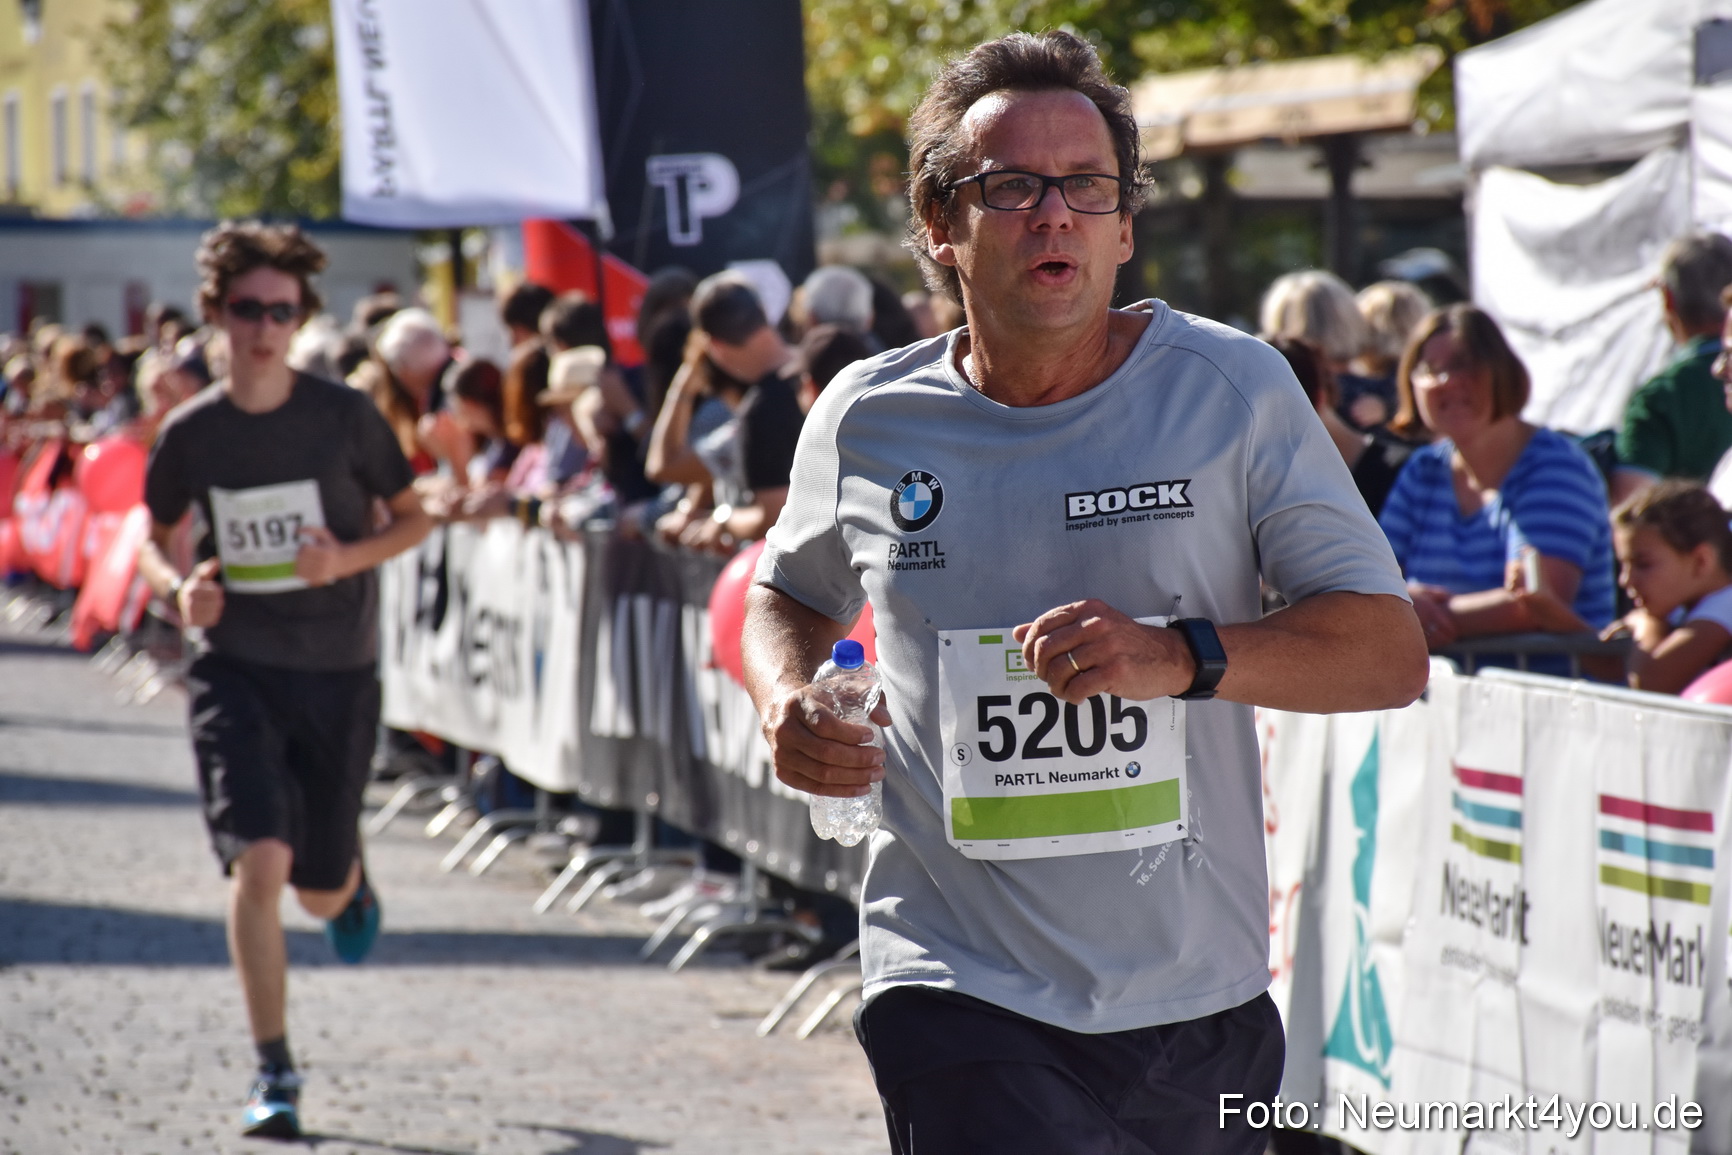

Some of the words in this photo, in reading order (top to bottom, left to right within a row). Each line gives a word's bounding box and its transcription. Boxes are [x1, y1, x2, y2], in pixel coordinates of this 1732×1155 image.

[895, 471, 940, 494] BMW
[1065, 480, 1193, 519] BOCK
[1065, 519, 1104, 531] inspired
[1107, 517, 1119, 526] by
[1121, 513, 1150, 524] smart
[1153, 510, 1195, 520] concepts
[227, 513, 304, 550] 5197
[888, 541, 945, 558] PARTL
[887, 558, 946, 571] Neumarkt
[977, 692, 1148, 762] 5205
[957, 748, 966, 761] S
[995, 772, 1045, 787] PARTL
[1048, 766, 1120, 784] Neumarkt
[1137, 872, 1153, 887] 16.
